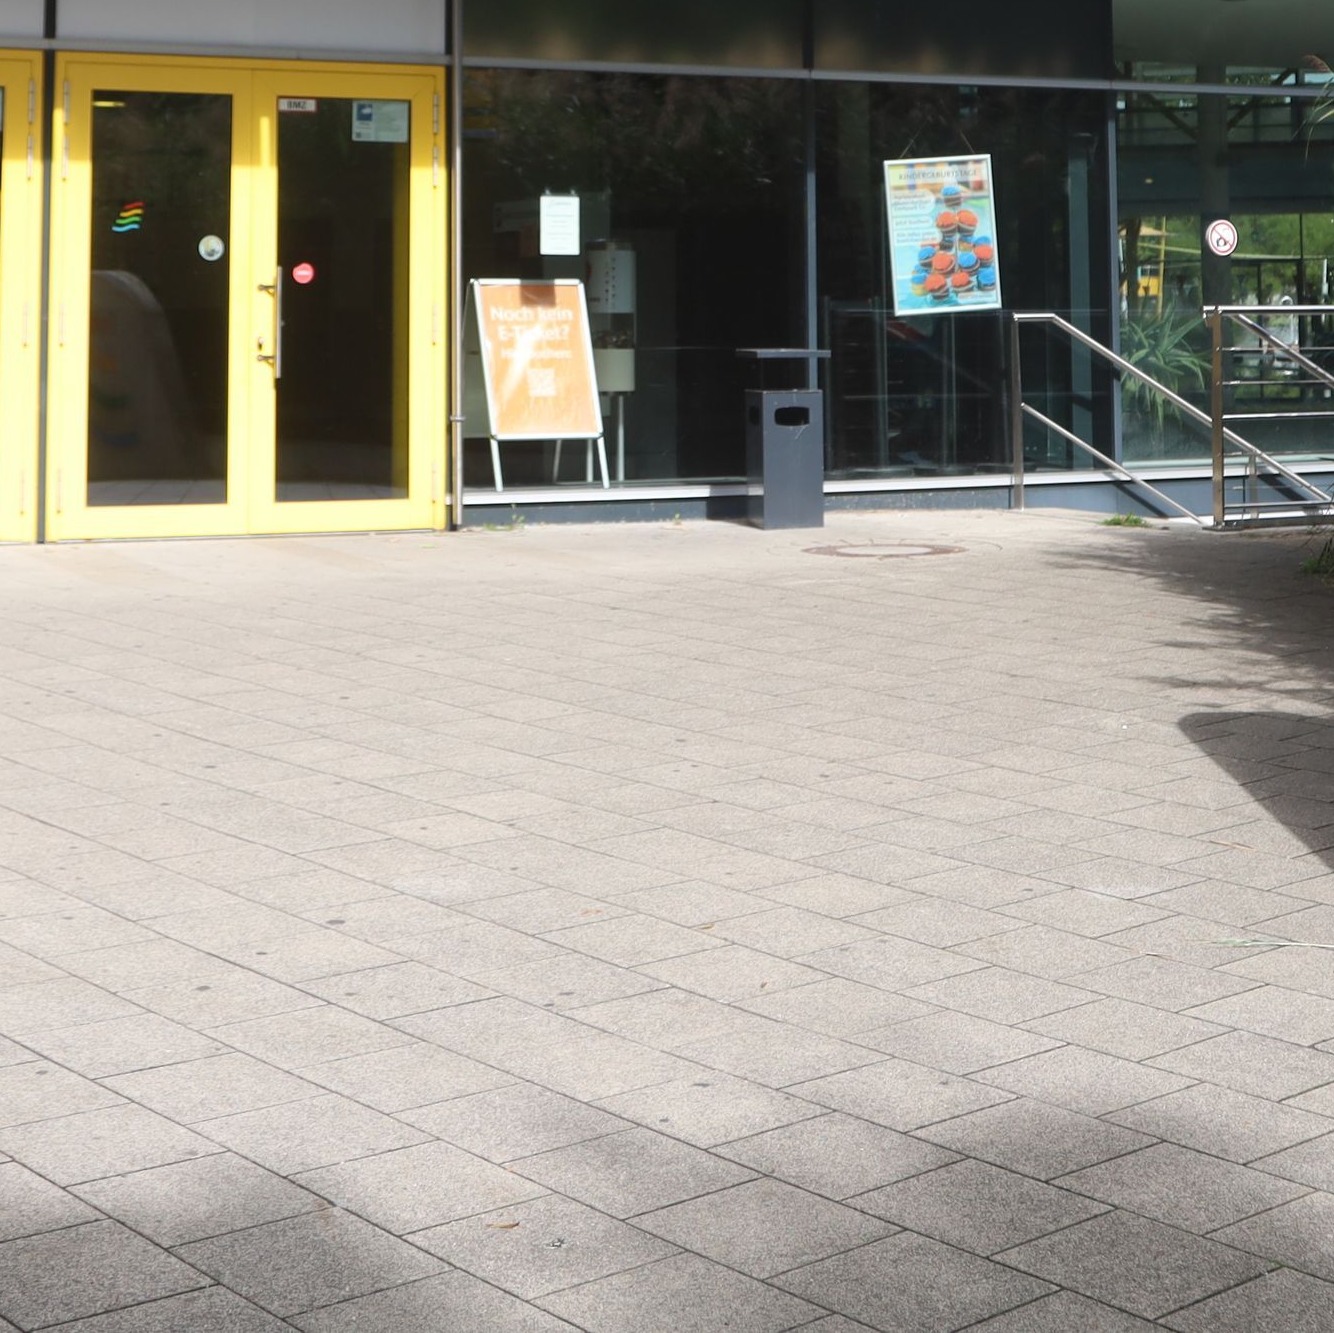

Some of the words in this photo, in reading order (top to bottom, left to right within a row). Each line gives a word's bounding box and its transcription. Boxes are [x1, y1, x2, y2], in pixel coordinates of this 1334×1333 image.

[490, 306, 535, 322] Noch
[538, 306, 573, 322] kein
[498, 324, 572, 341] E-Tket?
